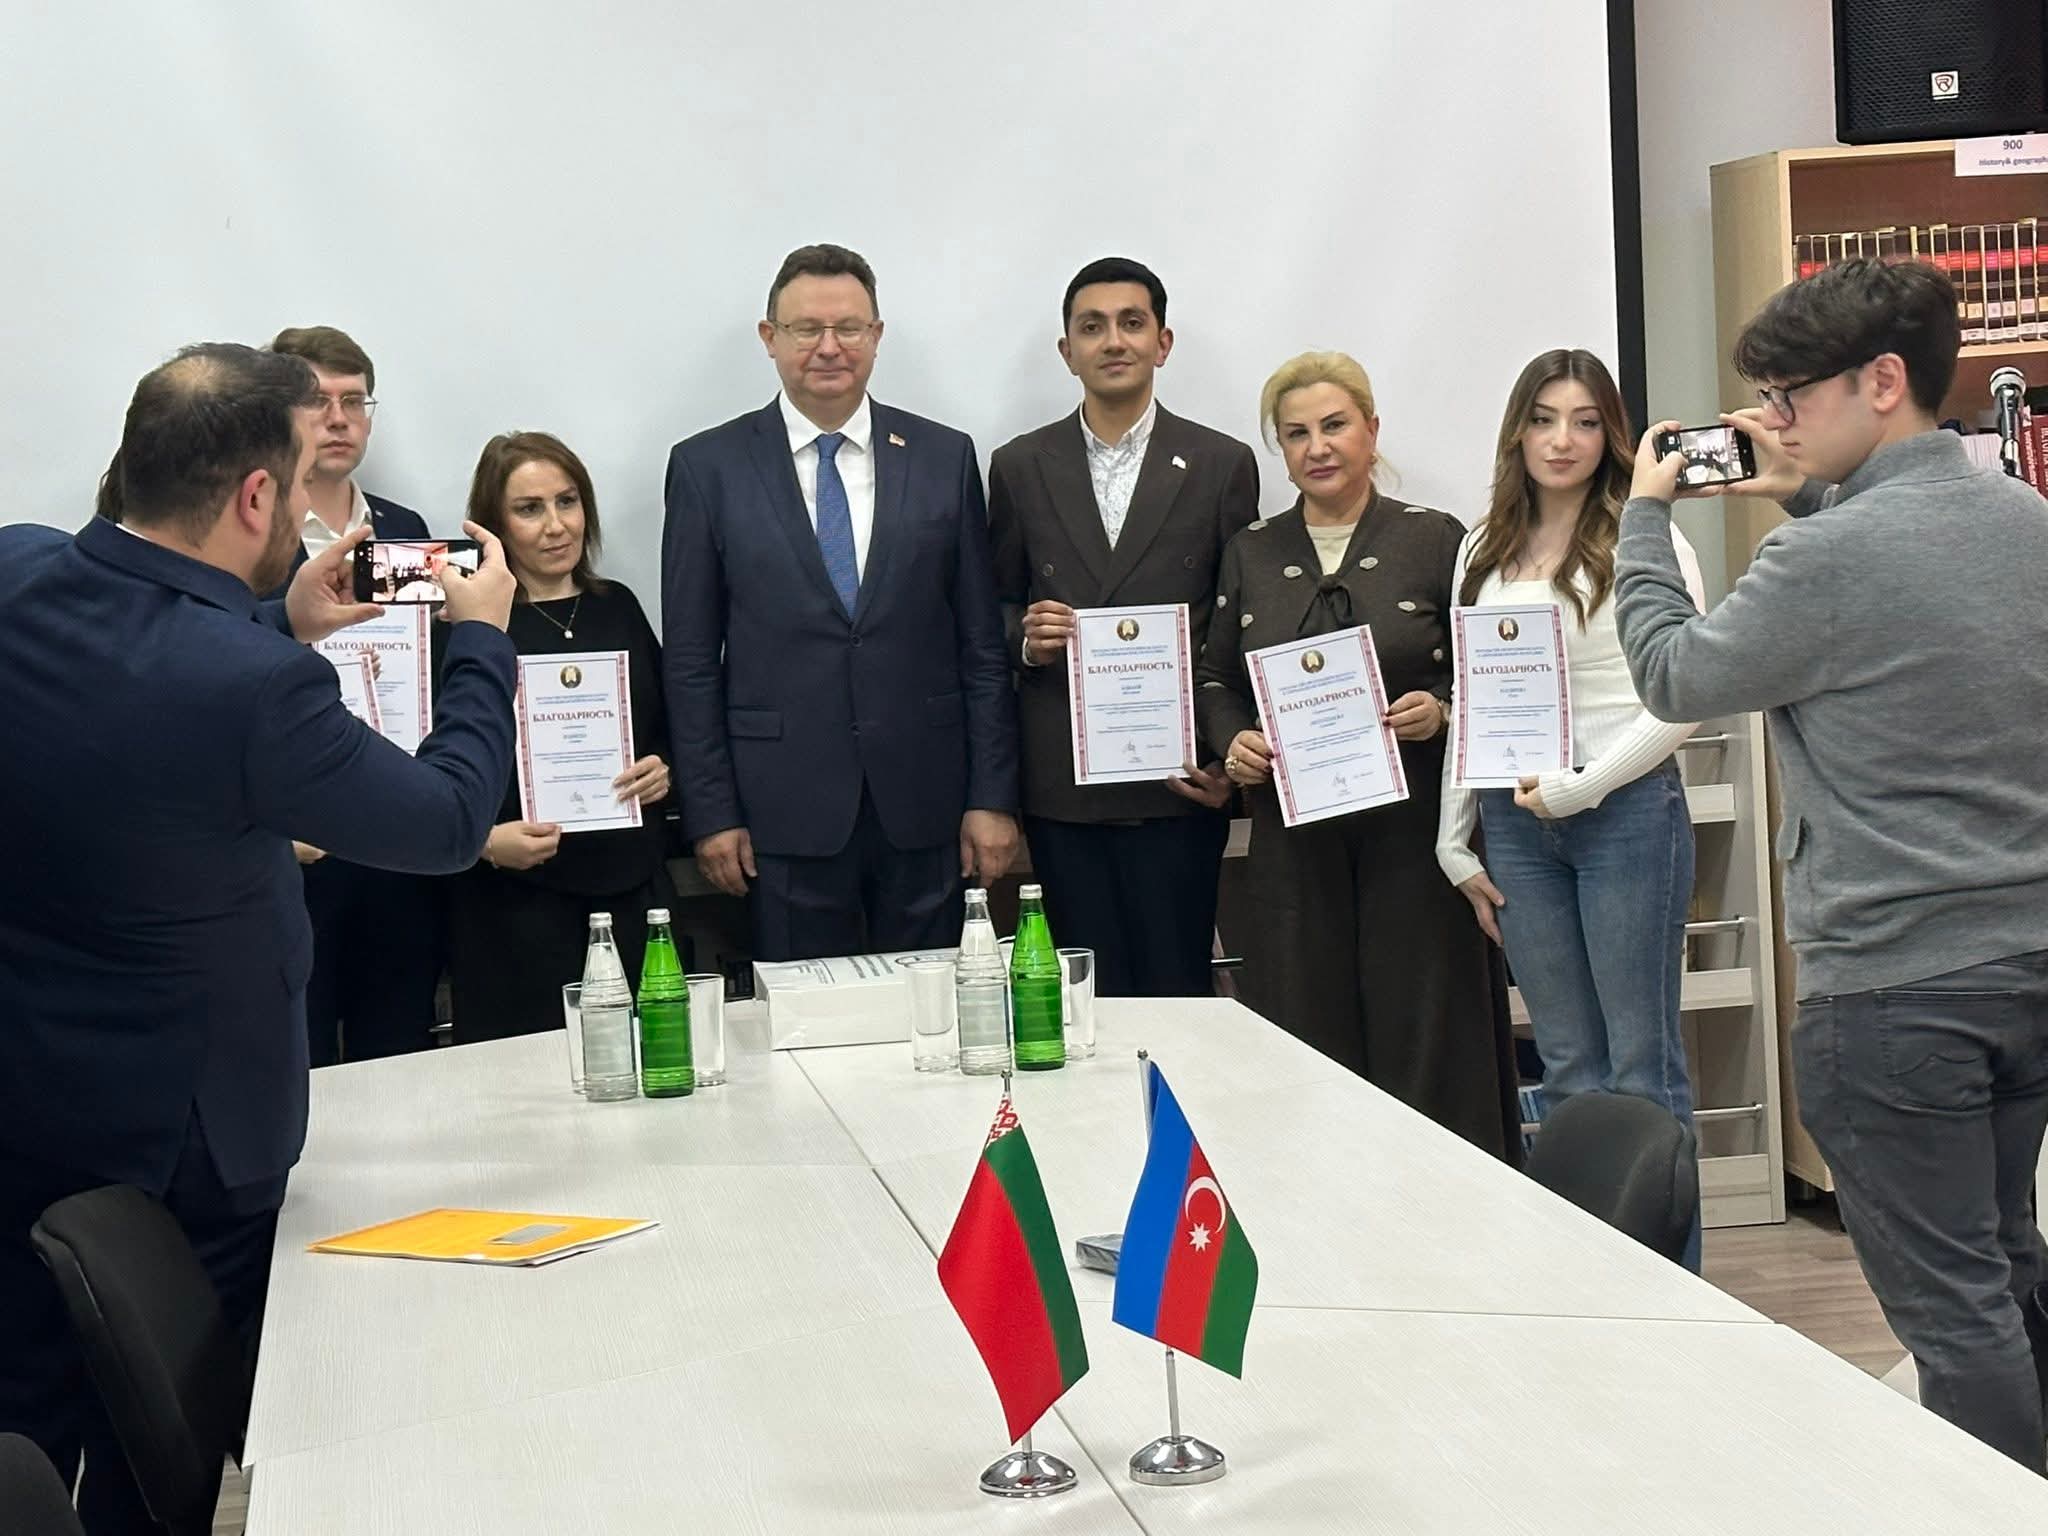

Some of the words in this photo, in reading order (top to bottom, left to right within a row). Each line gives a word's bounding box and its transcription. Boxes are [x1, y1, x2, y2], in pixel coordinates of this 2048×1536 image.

[2003, 139, 2023, 150] 900
[323, 641, 412, 651] БЛАГОДАРНОСТЬ
[1087, 661, 1174, 675] БЛАГОДАРНОСТЬ
[1472, 663, 1552, 675] БЛАГОДАРНОСТЬ
[1279, 687, 1366, 713] БЛАГОДАРНОСТЬ
[533, 710, 615, 723] БЛАГОДАРНОСТЬ
